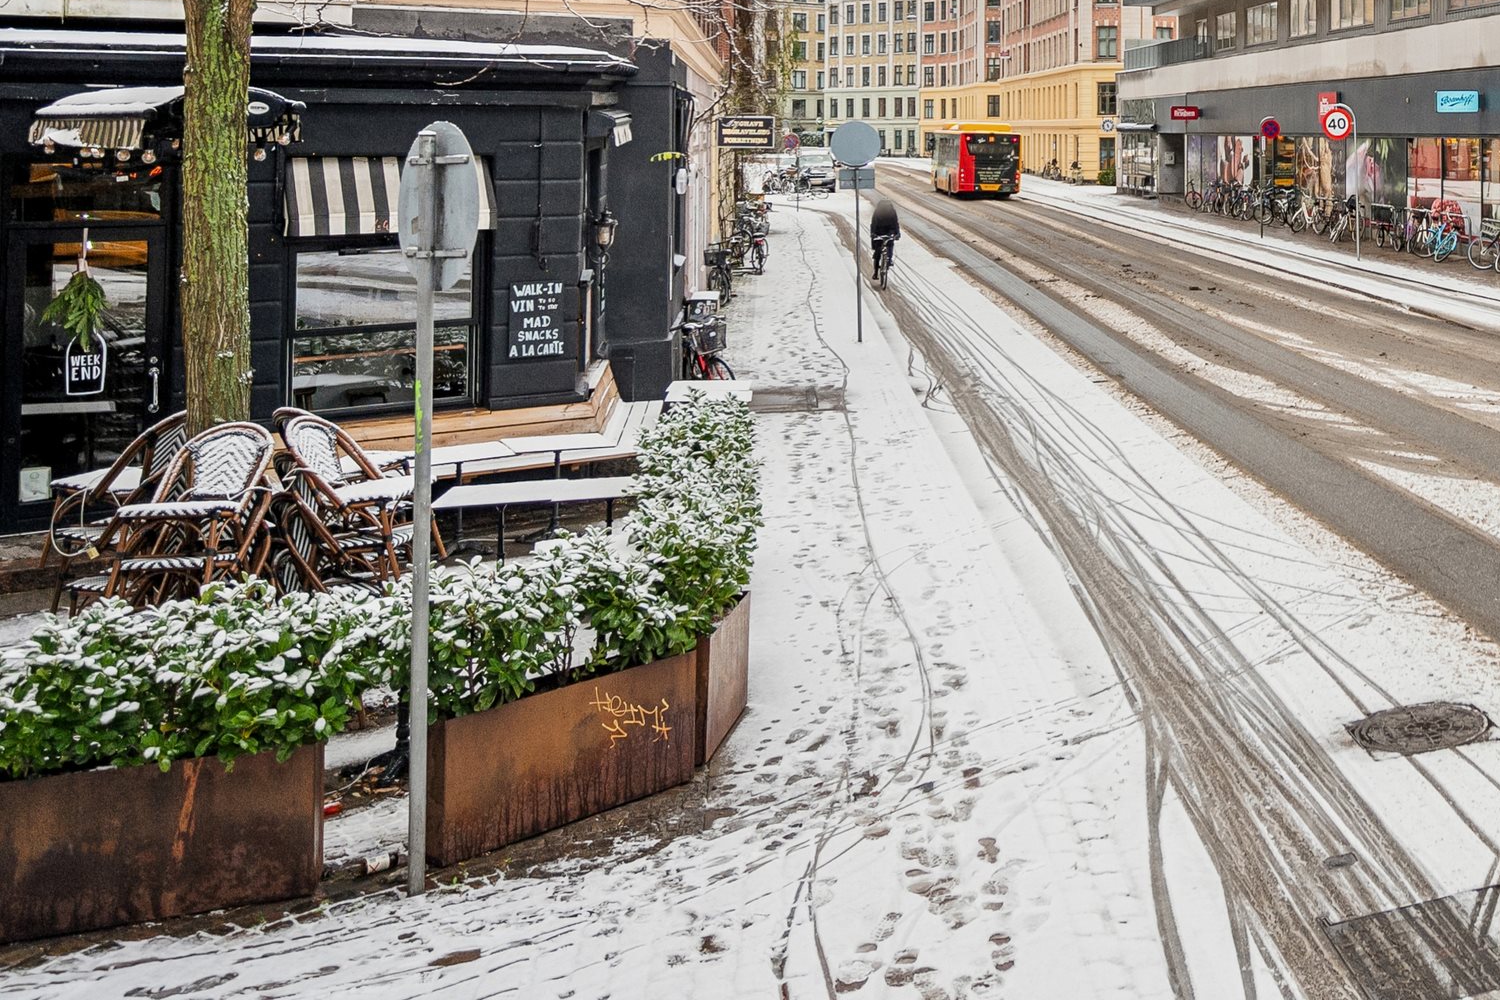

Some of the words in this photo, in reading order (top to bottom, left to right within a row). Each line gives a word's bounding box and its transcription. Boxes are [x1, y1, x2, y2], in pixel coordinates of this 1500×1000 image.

[1328, 117, 1347, 130] 40
[513, 282, 563, 297] WALK-IN
[511, 299, 535, 313] VIN
[523, 315, 551, 329] MAD
[517, 328, 559, 342] SNACKS
[508, 344, 518, 357] A
[522, 344, 535, 357] LA
[536, 340, 565, 356] CARTE
[70, 353, 101, 367] WEEK
[71, 365, 101, 381] END
